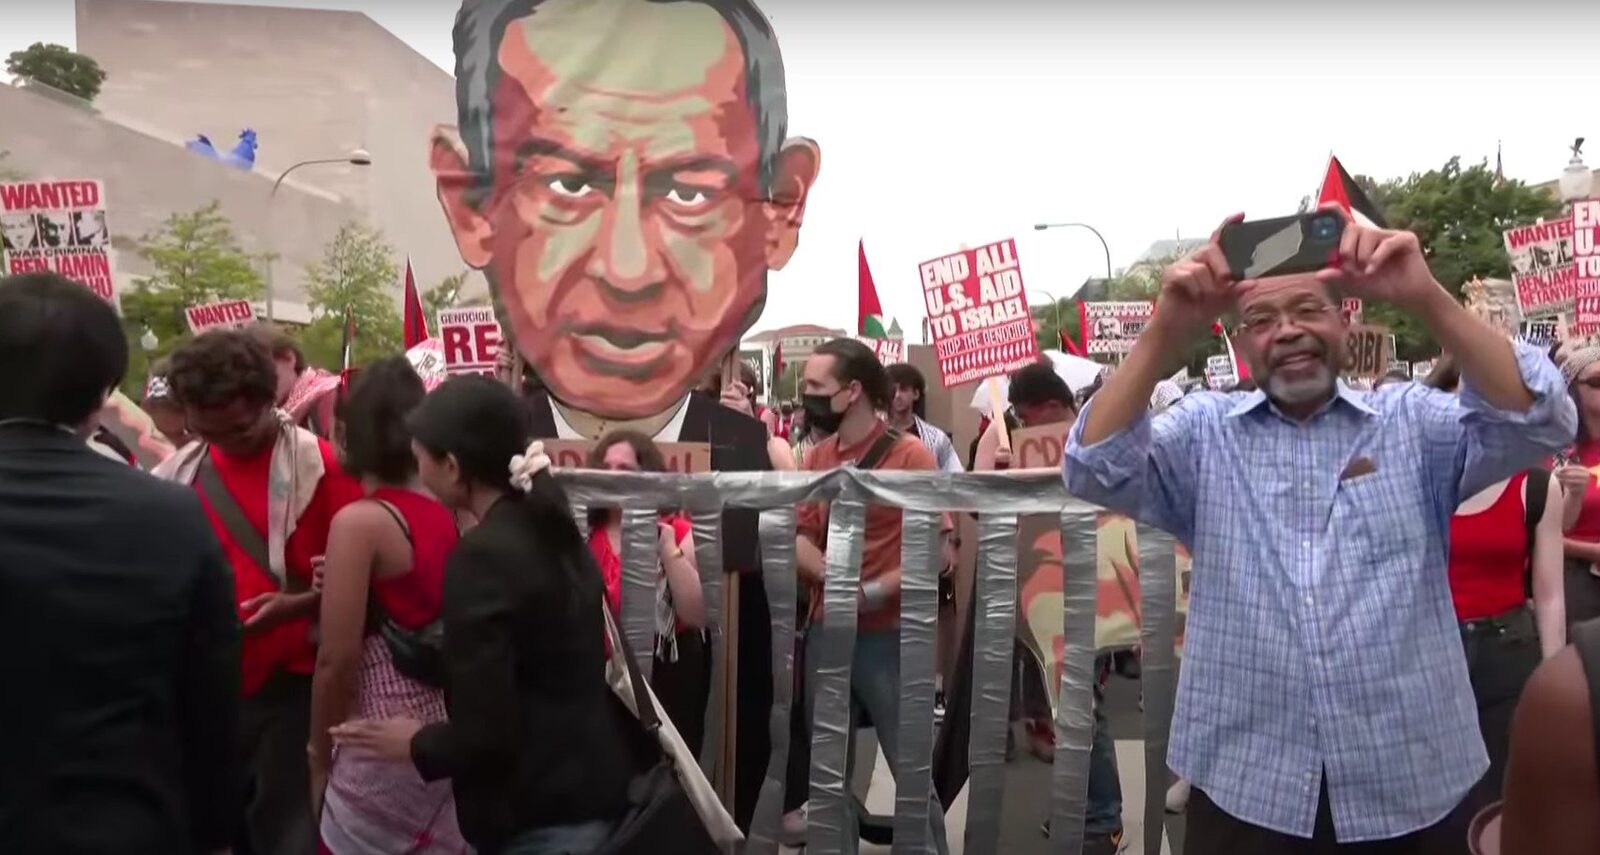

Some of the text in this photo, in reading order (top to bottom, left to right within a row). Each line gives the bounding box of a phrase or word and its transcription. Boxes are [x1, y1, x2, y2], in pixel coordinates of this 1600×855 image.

[0, 182, 99, 210] WANTED
[1575, 201, 1600, 228] EN
[9, 246, 107, 258] WAR CRIMINAL
[921, 242, 1018, 290] END ALL
[1576, 257, 1600, 278] TO
[1518, 267, 1574, 293] BENJAM
[926, 270, 1022, 317] U.S. AID
[1520, 284, 1574, 309] NETANY
[190, 301, 252, 327] WANTED
[441, 311, 489, 324] GENOCIDE
[931, 296, 1027, 339] TO ISRAEL
[939, 321, 1030, 357] STOP THE GENOCIDE
[1529, 322, 1558, 340] FREE
